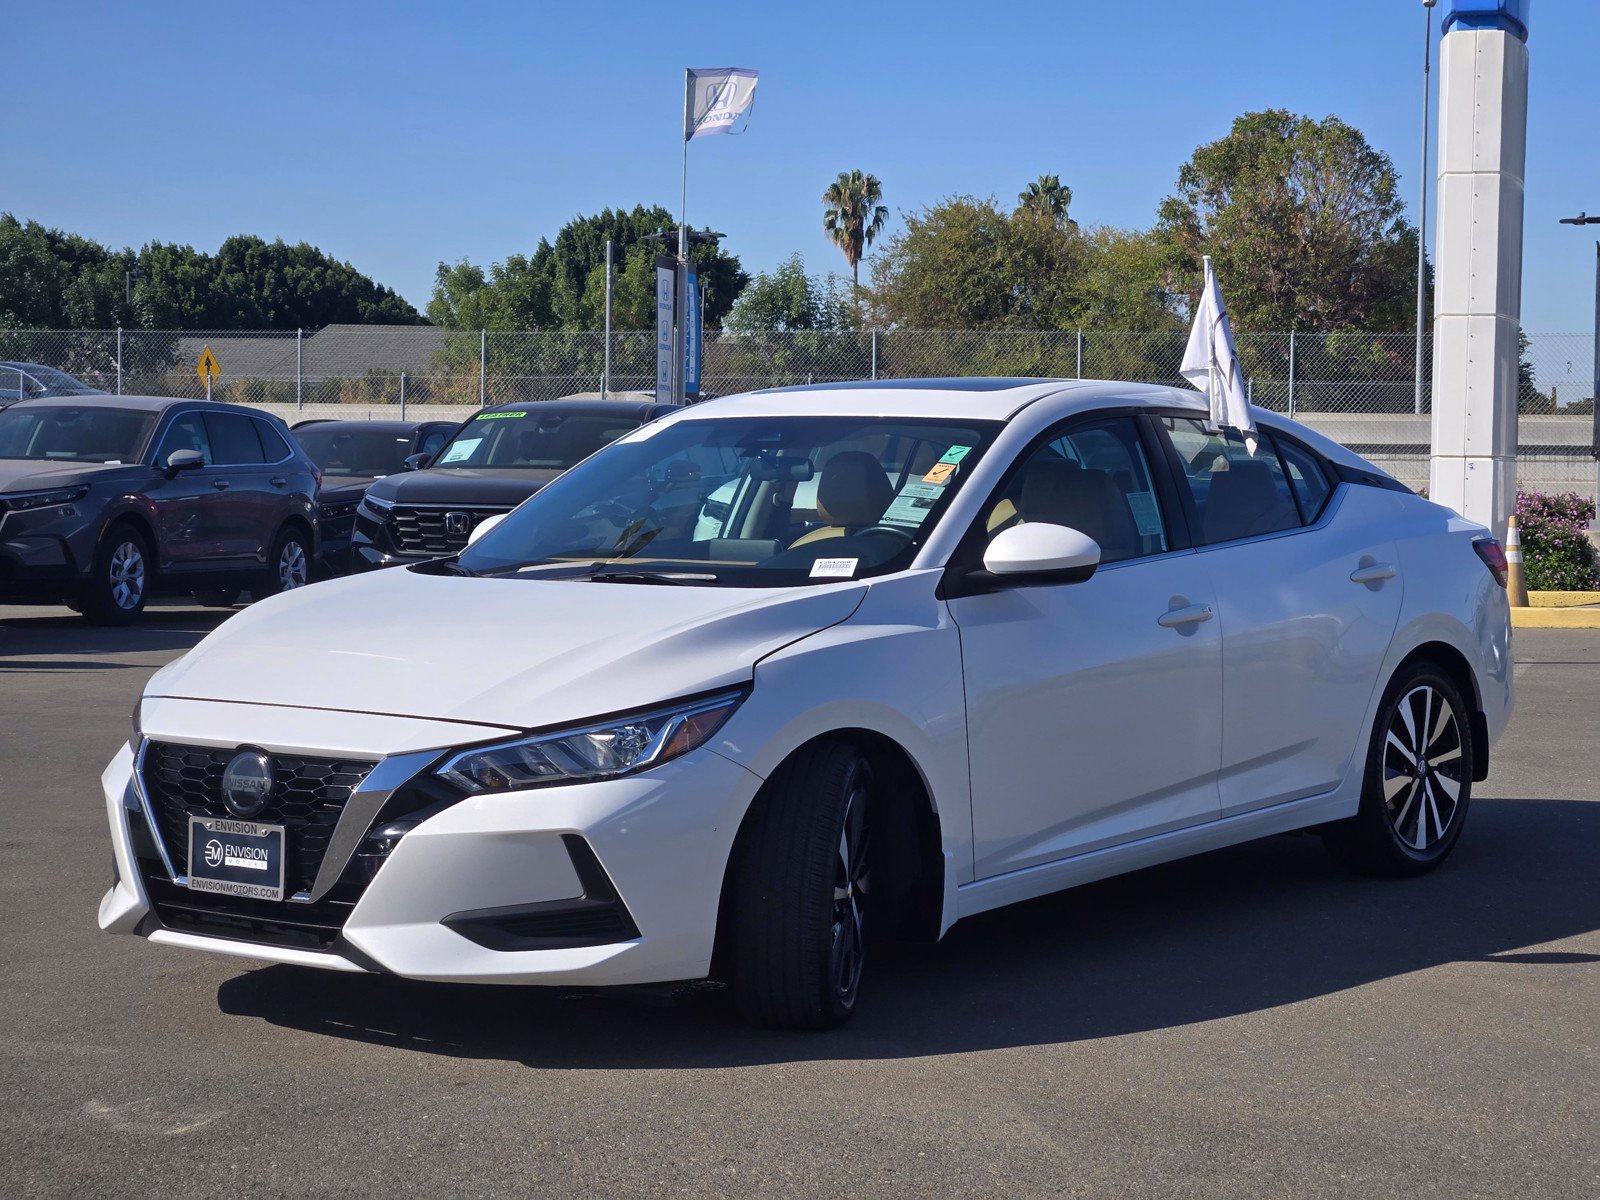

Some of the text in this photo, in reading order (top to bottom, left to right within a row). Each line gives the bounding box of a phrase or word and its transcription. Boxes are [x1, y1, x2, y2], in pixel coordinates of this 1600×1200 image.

[229, 778, 266, 790] NISSAN
[215, 820, 258, 835] ENVISION
[225, 844, 268, 860] ENVISION
[191, 879, 279, 899] ENVISIONMOTORS.COM
